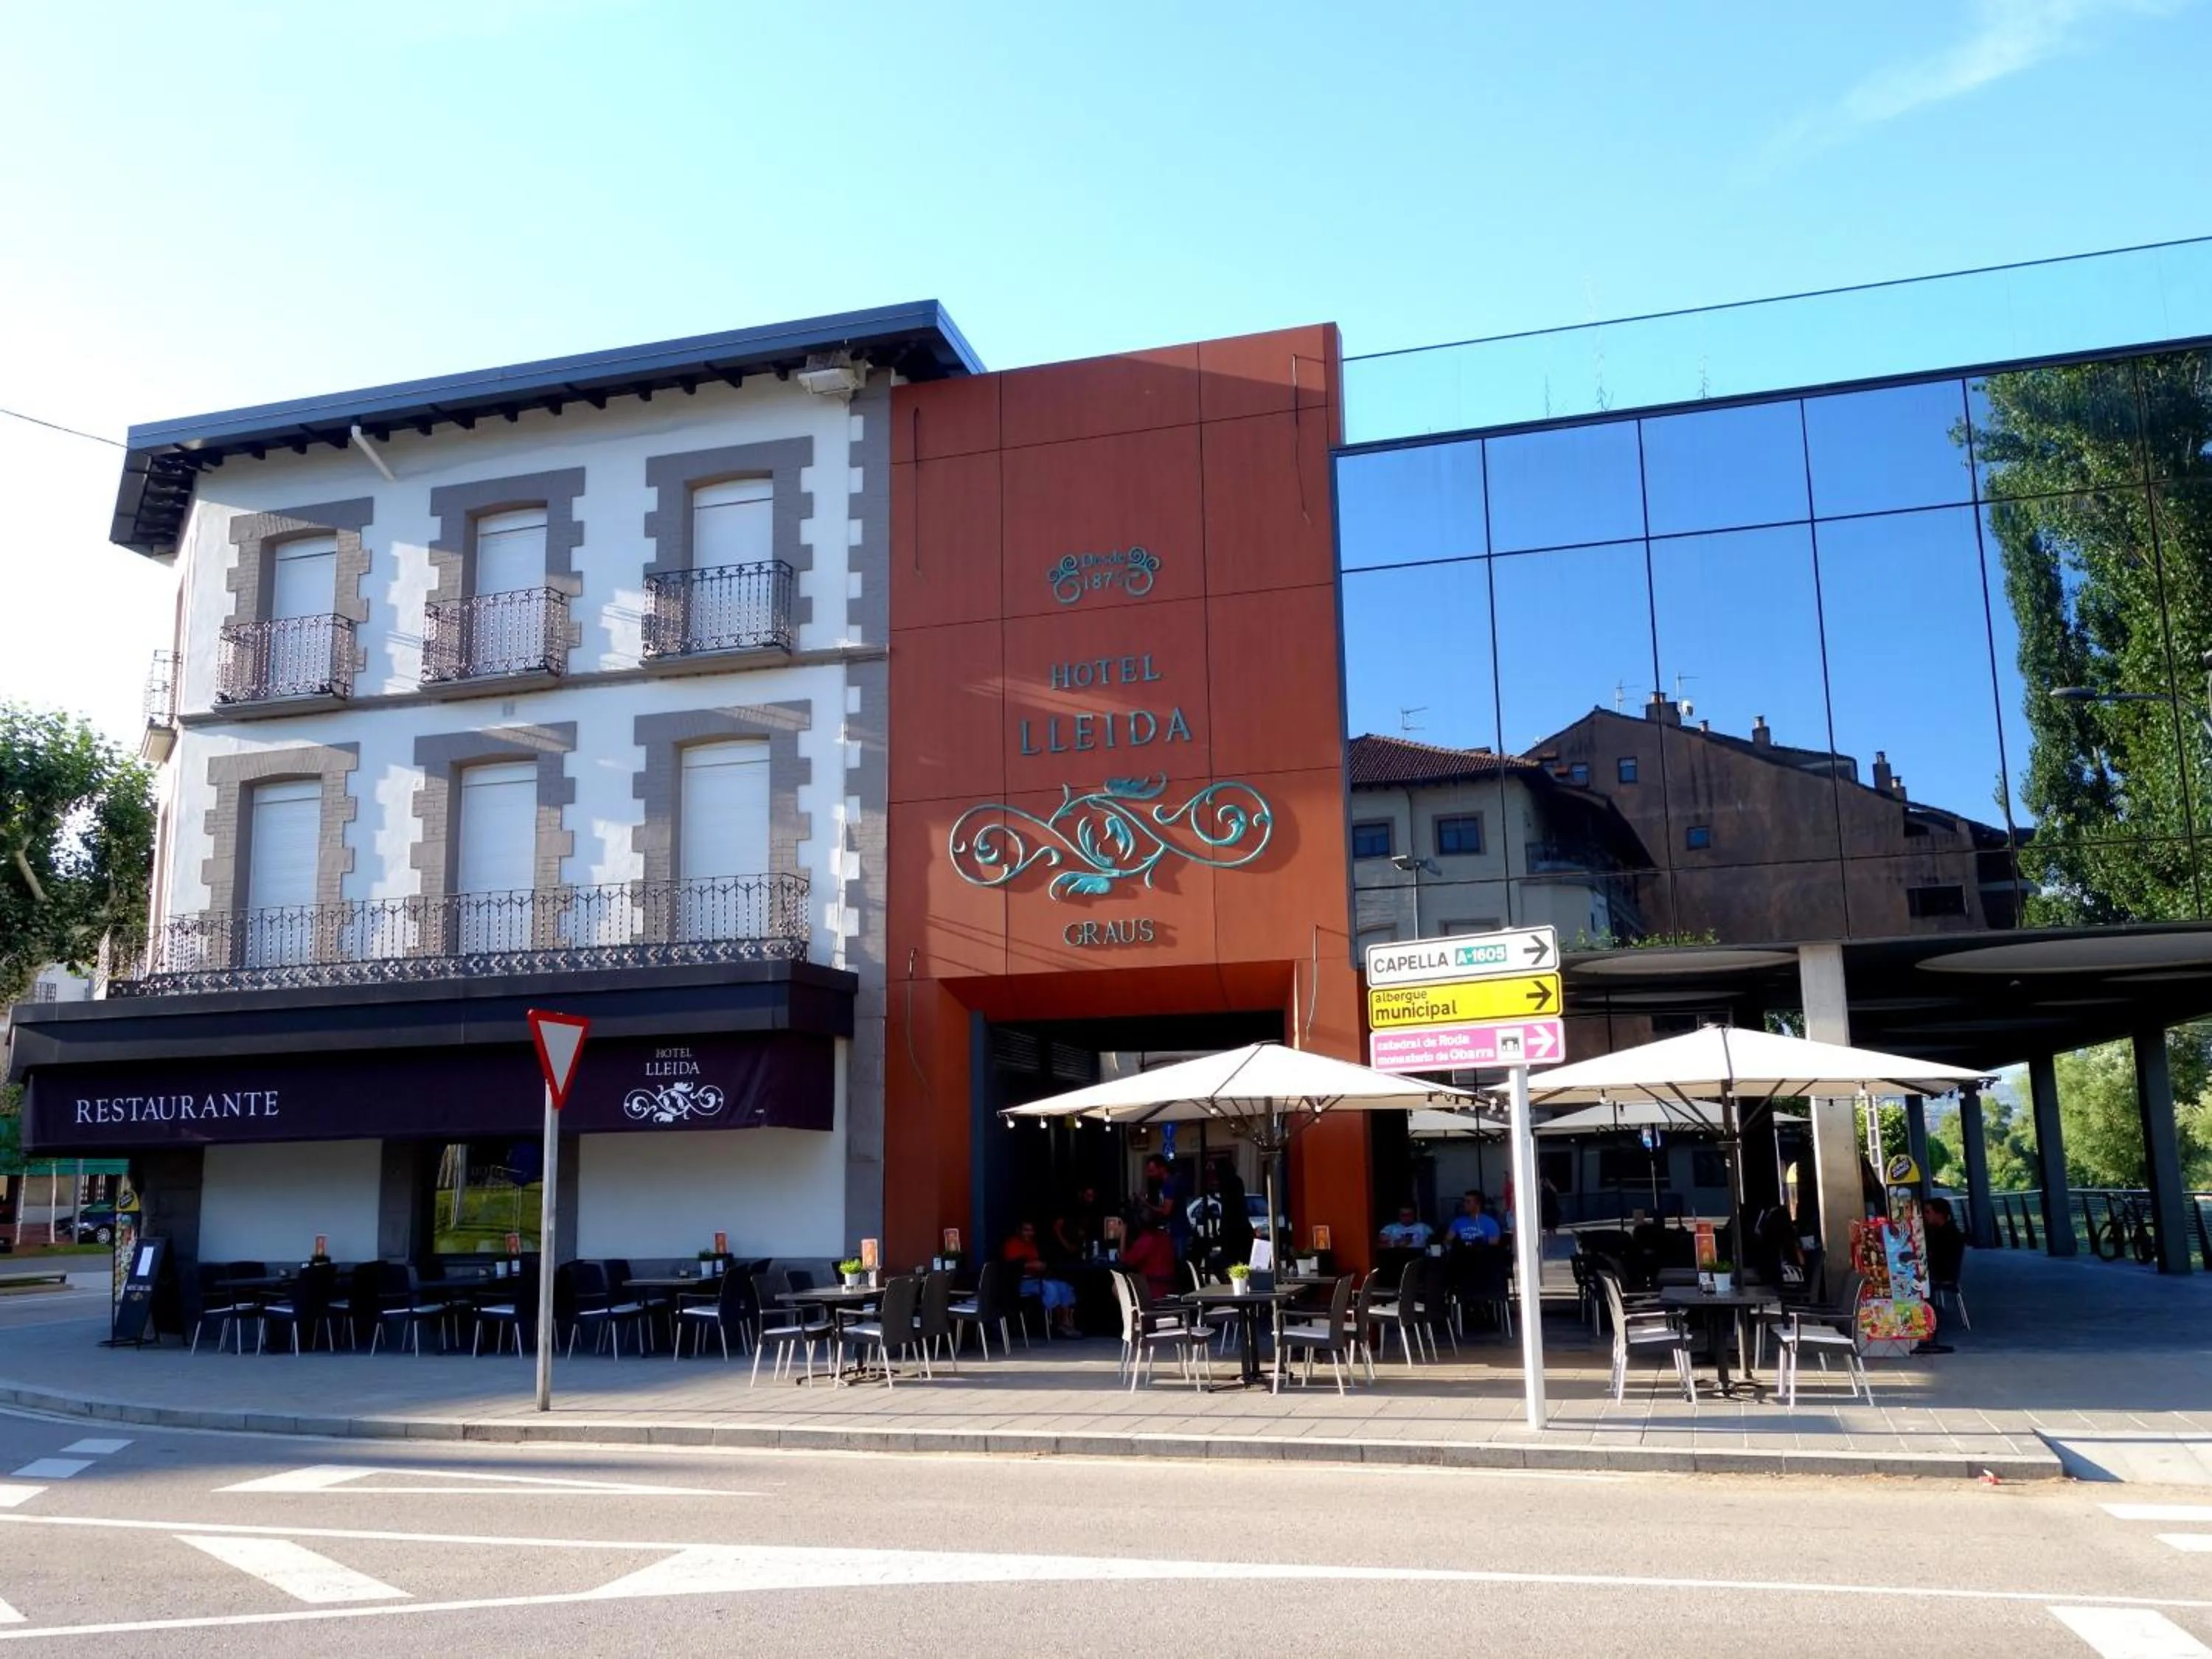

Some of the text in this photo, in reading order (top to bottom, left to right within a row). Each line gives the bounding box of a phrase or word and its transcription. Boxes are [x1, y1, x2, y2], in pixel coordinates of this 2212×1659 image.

[1051, 653, 1162, 690] HOTEL
[1020, 707, 1192, 756] LLEIDA
[1062, 919, 1155, 947] GRAUS
[1374, 947, 1506, 973] CAPELLA A-1605
[1375, 990, 1427, 1004] albergue
[1376, 1000, 1458, 1021] municipal
[1439, 1034, 1470, 1046] Roda
[655, 1048, 692, 1058] HOTEL
[1450, 1048, 1495, 1060] Obarra
[646, 1061, 700, 1076] LLEIDA
[75, 1091, 279, 1123] RESTAURANTE
